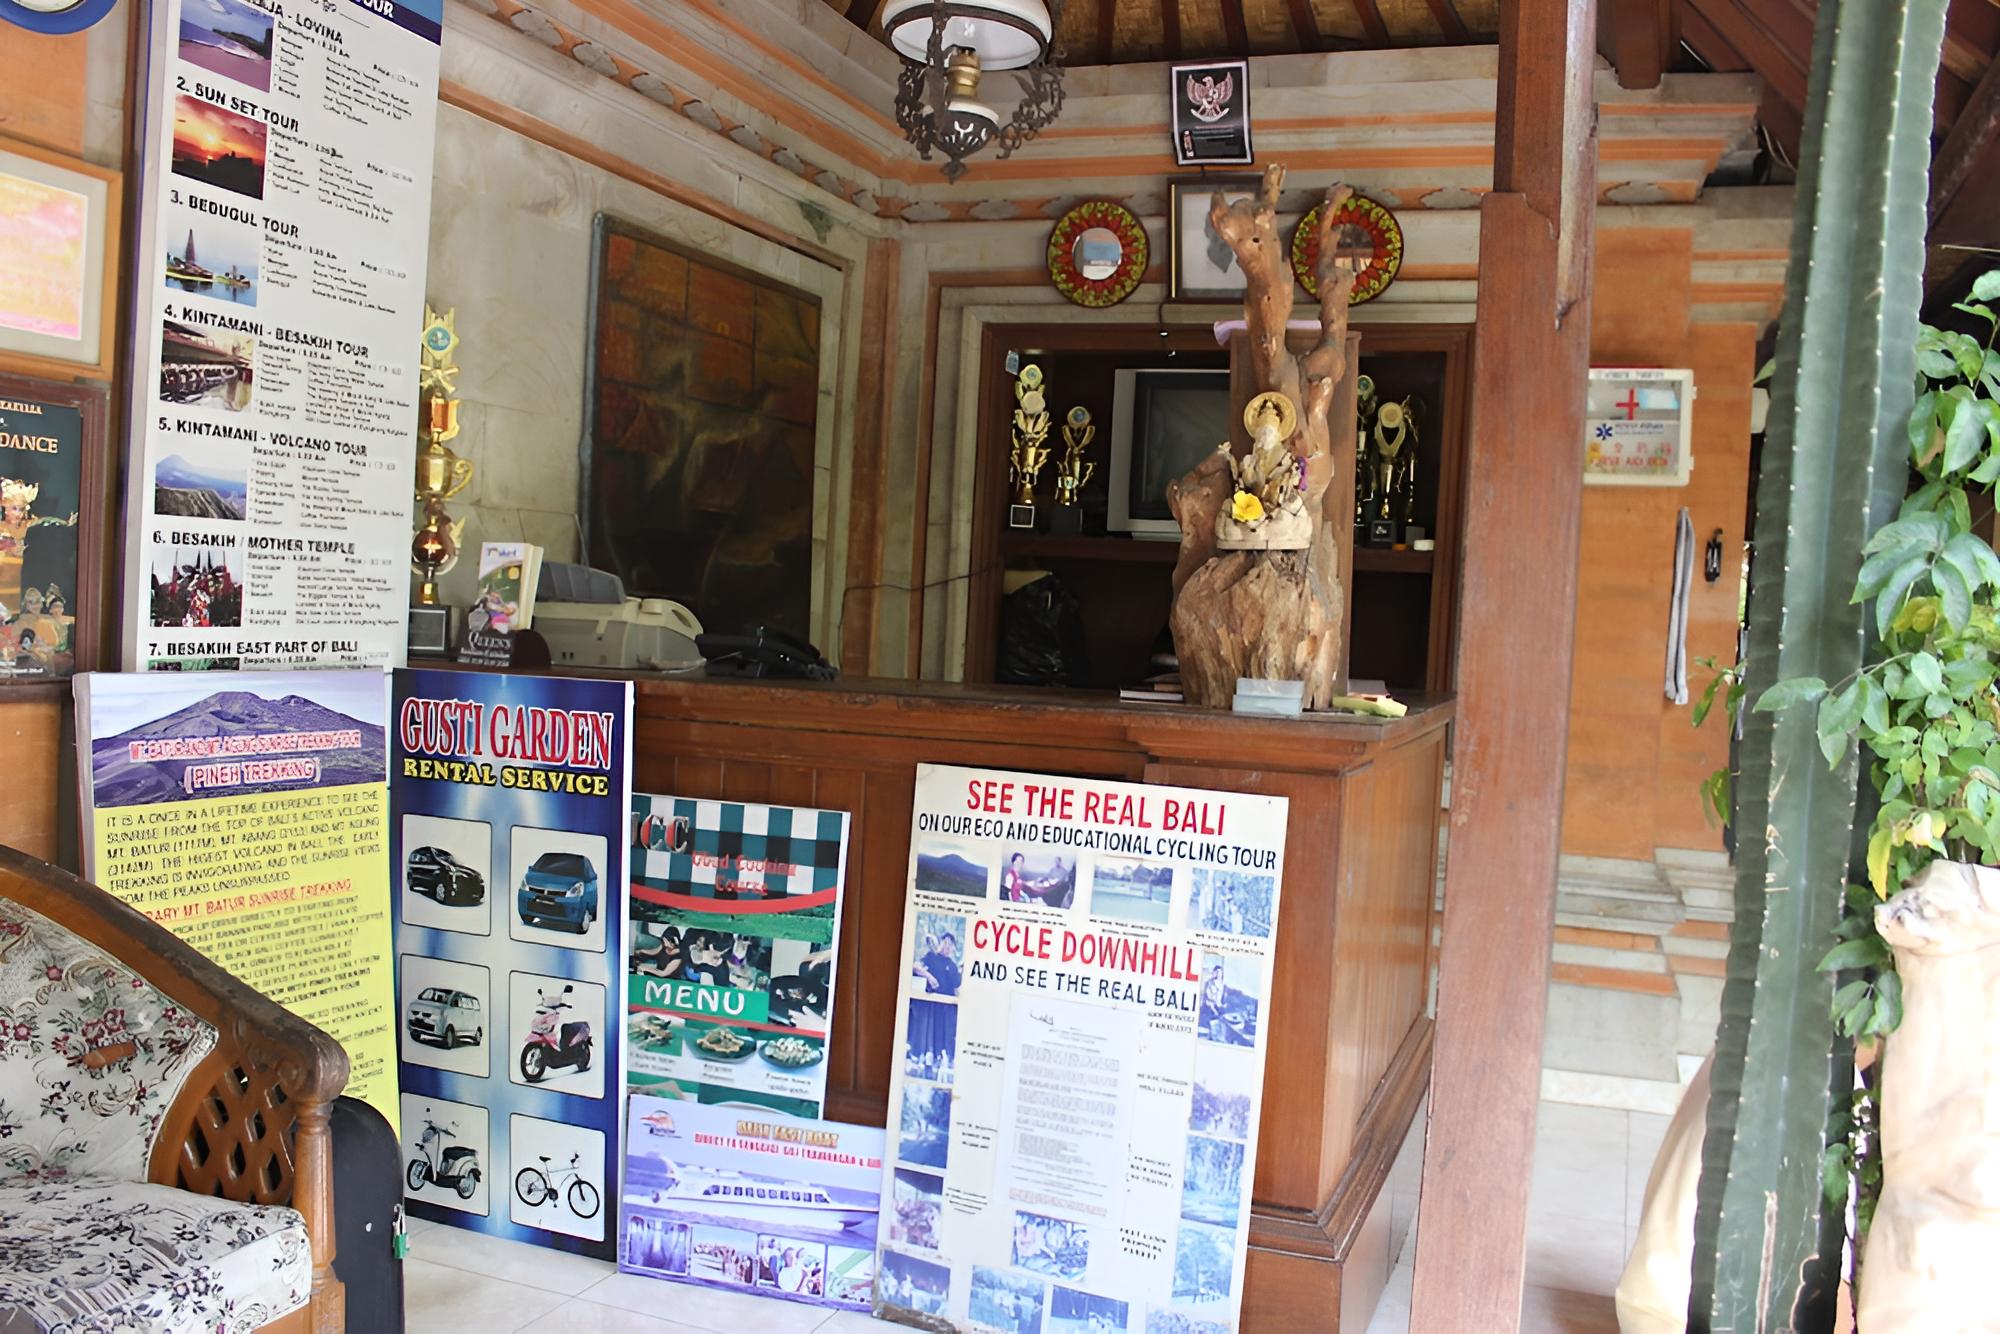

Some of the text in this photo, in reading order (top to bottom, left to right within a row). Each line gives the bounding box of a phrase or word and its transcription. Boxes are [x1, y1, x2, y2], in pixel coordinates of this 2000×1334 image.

[296, 13, 343, 44] LOVINA
[176, 76, 299, 132] 2. SUN SET TOUR
[170, 190, 299, 238] 3. BEDUGUL TOUR
[164, 304, 177, 318] 4.
[183, 307, 263, 337] KINTAMANI
[276, 328, 332, 351] BESAKIH
[336, 340, 369, 358] TOUR
[0, 432, 58, 453] DANCE
[158, 418, 171, 432] 5.
[177, 420, 258, 443] KINTAMANI
[270, 433, 331, 453] VOLCANO
[335, 443, 367, 457] TOUR
[152, 531, 165, 545] 6.
[172, 532, 236, 549] BESAKIH
[247, 536, 303, 552] MOTHER
[307, 541, 355, 555] TEMPLE
[149, 641, 358, 656] 7. BESAKIH EAST PART OF BALI
[400, 697, 484, 757] GUSTI
[489, 704, 614, 770] GARDEN
[403, 758, 609, 798] RENTAL SERVICE
[966, 780, 1226, 836] SEE THE REAL BALI
[919, 813, 1276, 870] ON OUR ECO AND EDUCATIONAL CYCLING TOUR
[206, 896, 245, 914] BATUR
[249, 888, 295, 907] SUNRISE
[300, 878, 352, 897] TREKKING
[973, 920, 1053, 959] CYCLE
[1062, 930, 1199, 983] DOWNHILL
[644, 980, 745, 1016] MENU
[970, 960, 1197, 1012] AND SEE THE REAL BALI
